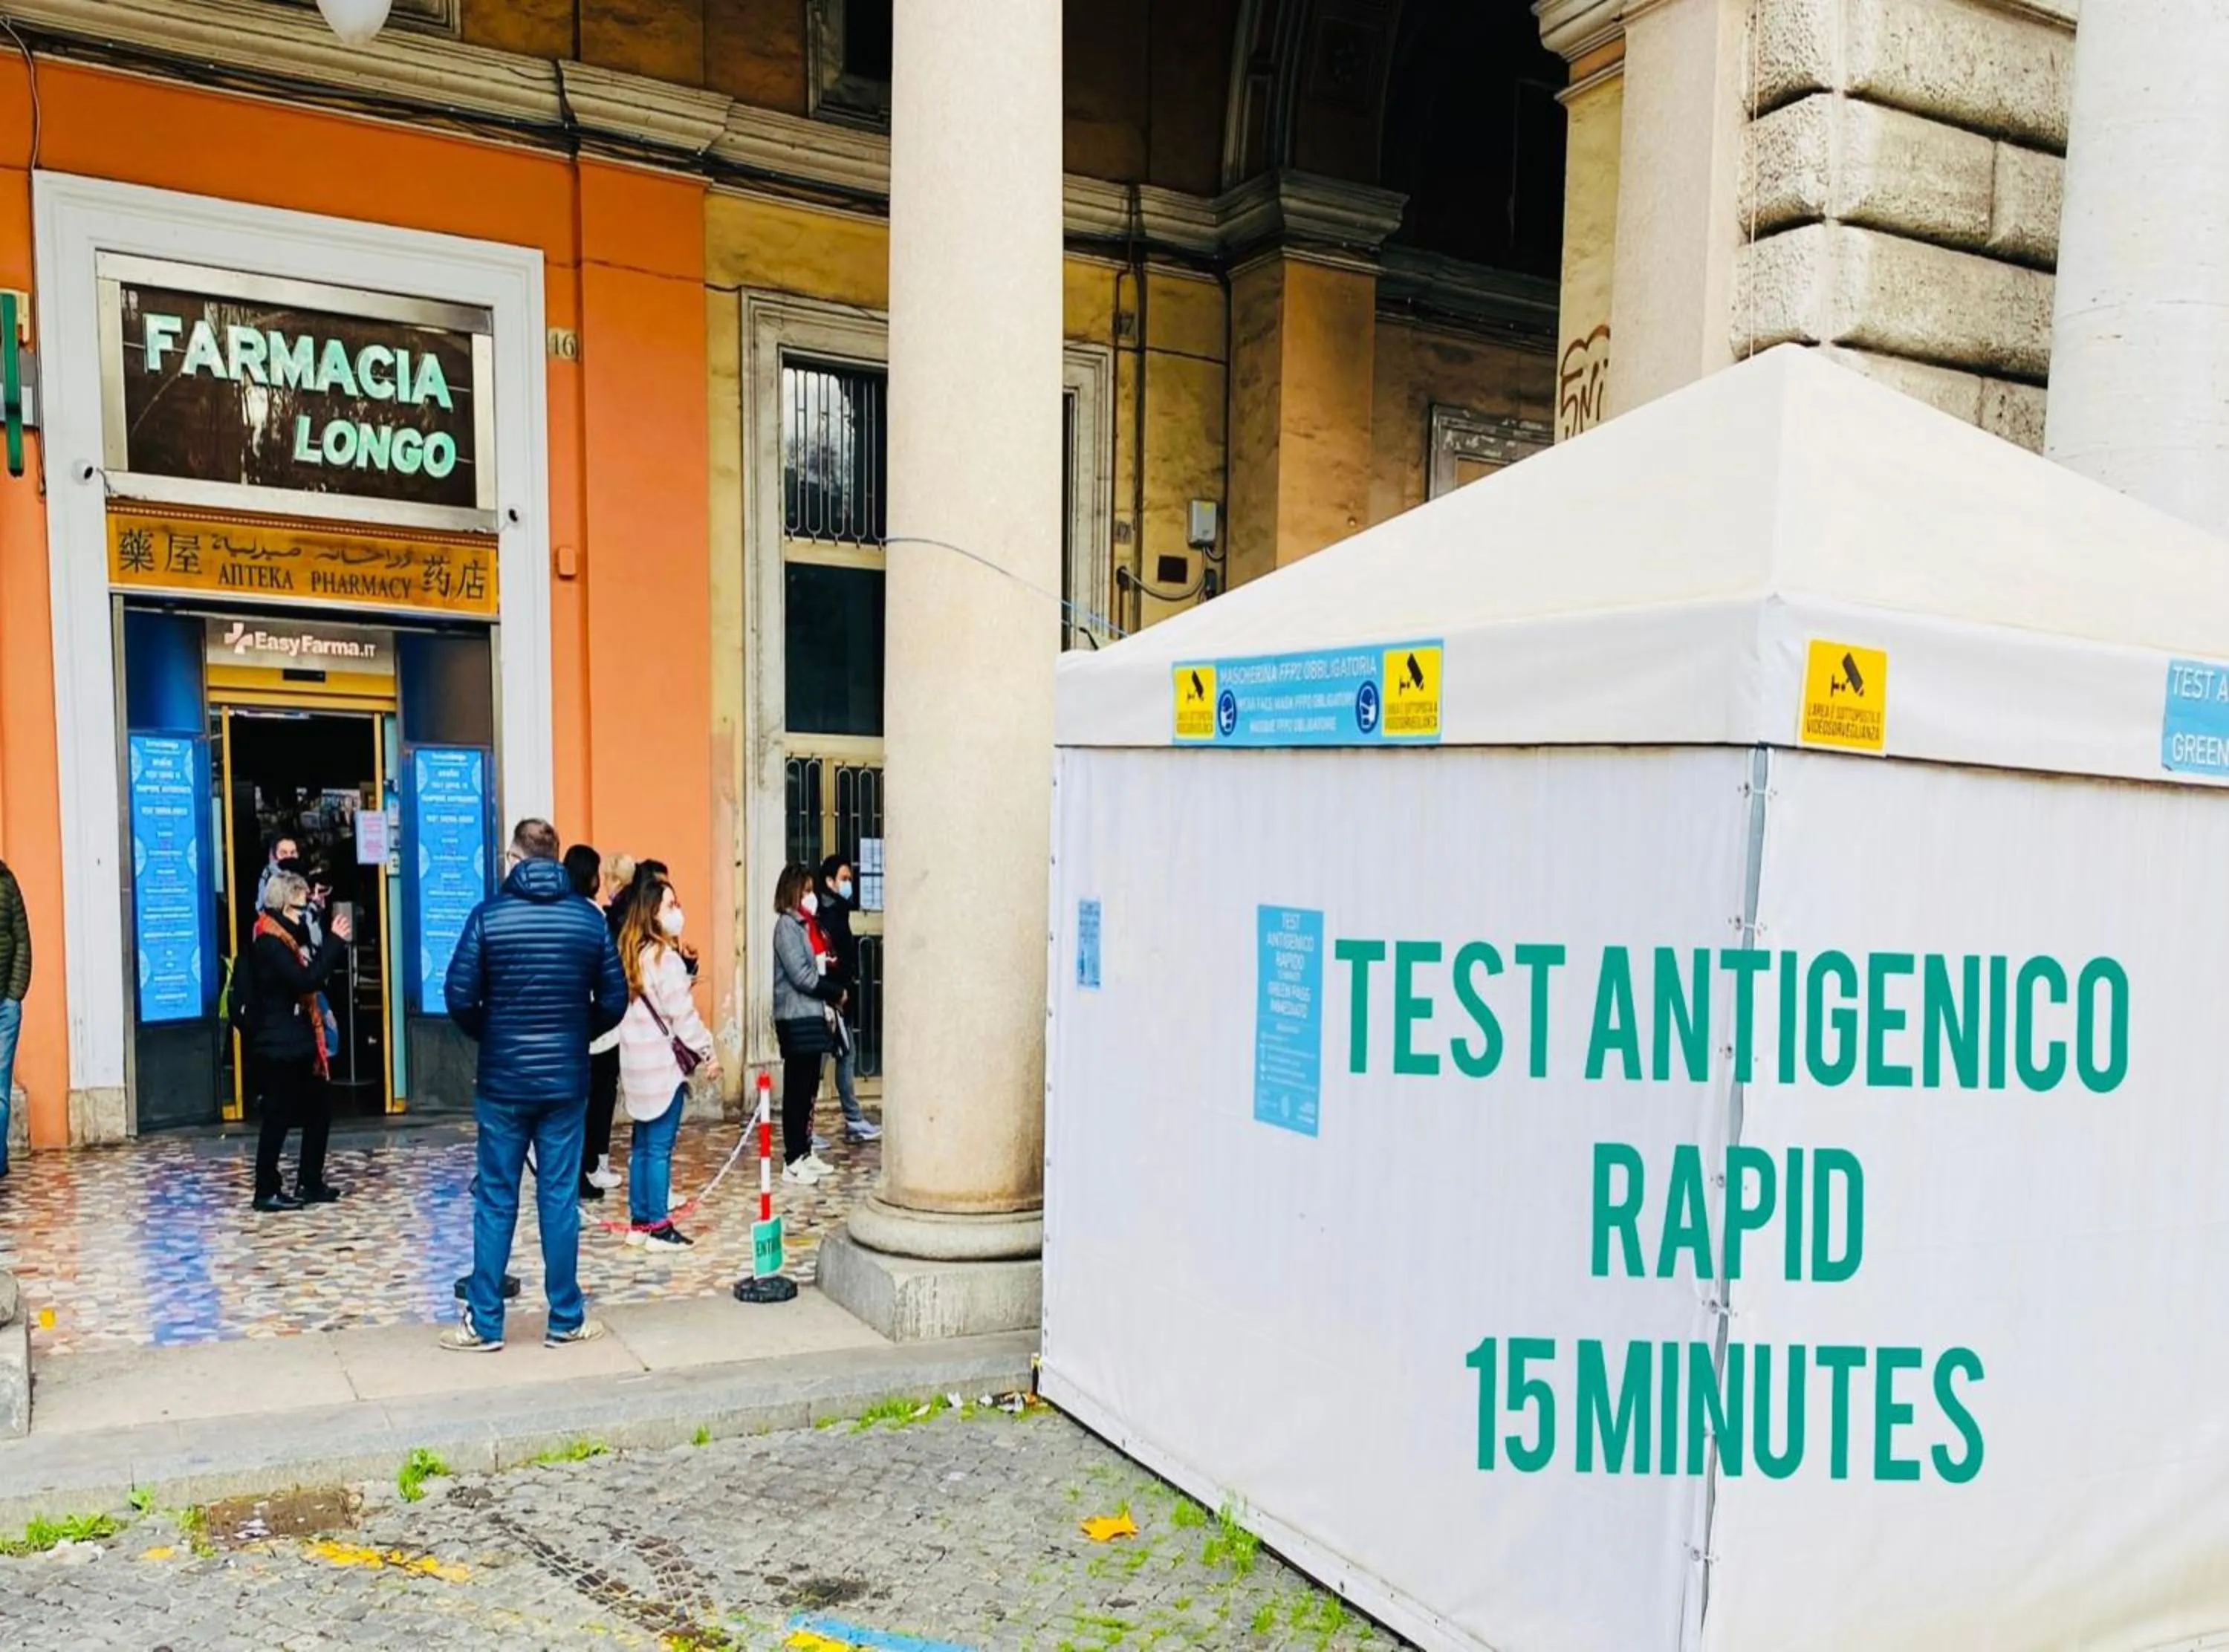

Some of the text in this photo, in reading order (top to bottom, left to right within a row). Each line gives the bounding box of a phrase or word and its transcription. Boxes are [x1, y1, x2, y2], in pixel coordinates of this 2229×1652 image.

[143, 313, 453, 413] FARMACIA
[551, 332, 574, 357] 16
[294, 414, 457, 479] LONGO
[311, 570, 412, 599] PHARMACY
[2173, 666, 2215, 700] TEST
[1336, 940, 1565, 1078] TEST
[1585, 946, 2128, 1093] ANTIGENICO
[1592, 1143, 1863, 1282] RAPID
[1466, 1337, 1985, 1483] 15 MINUTES
